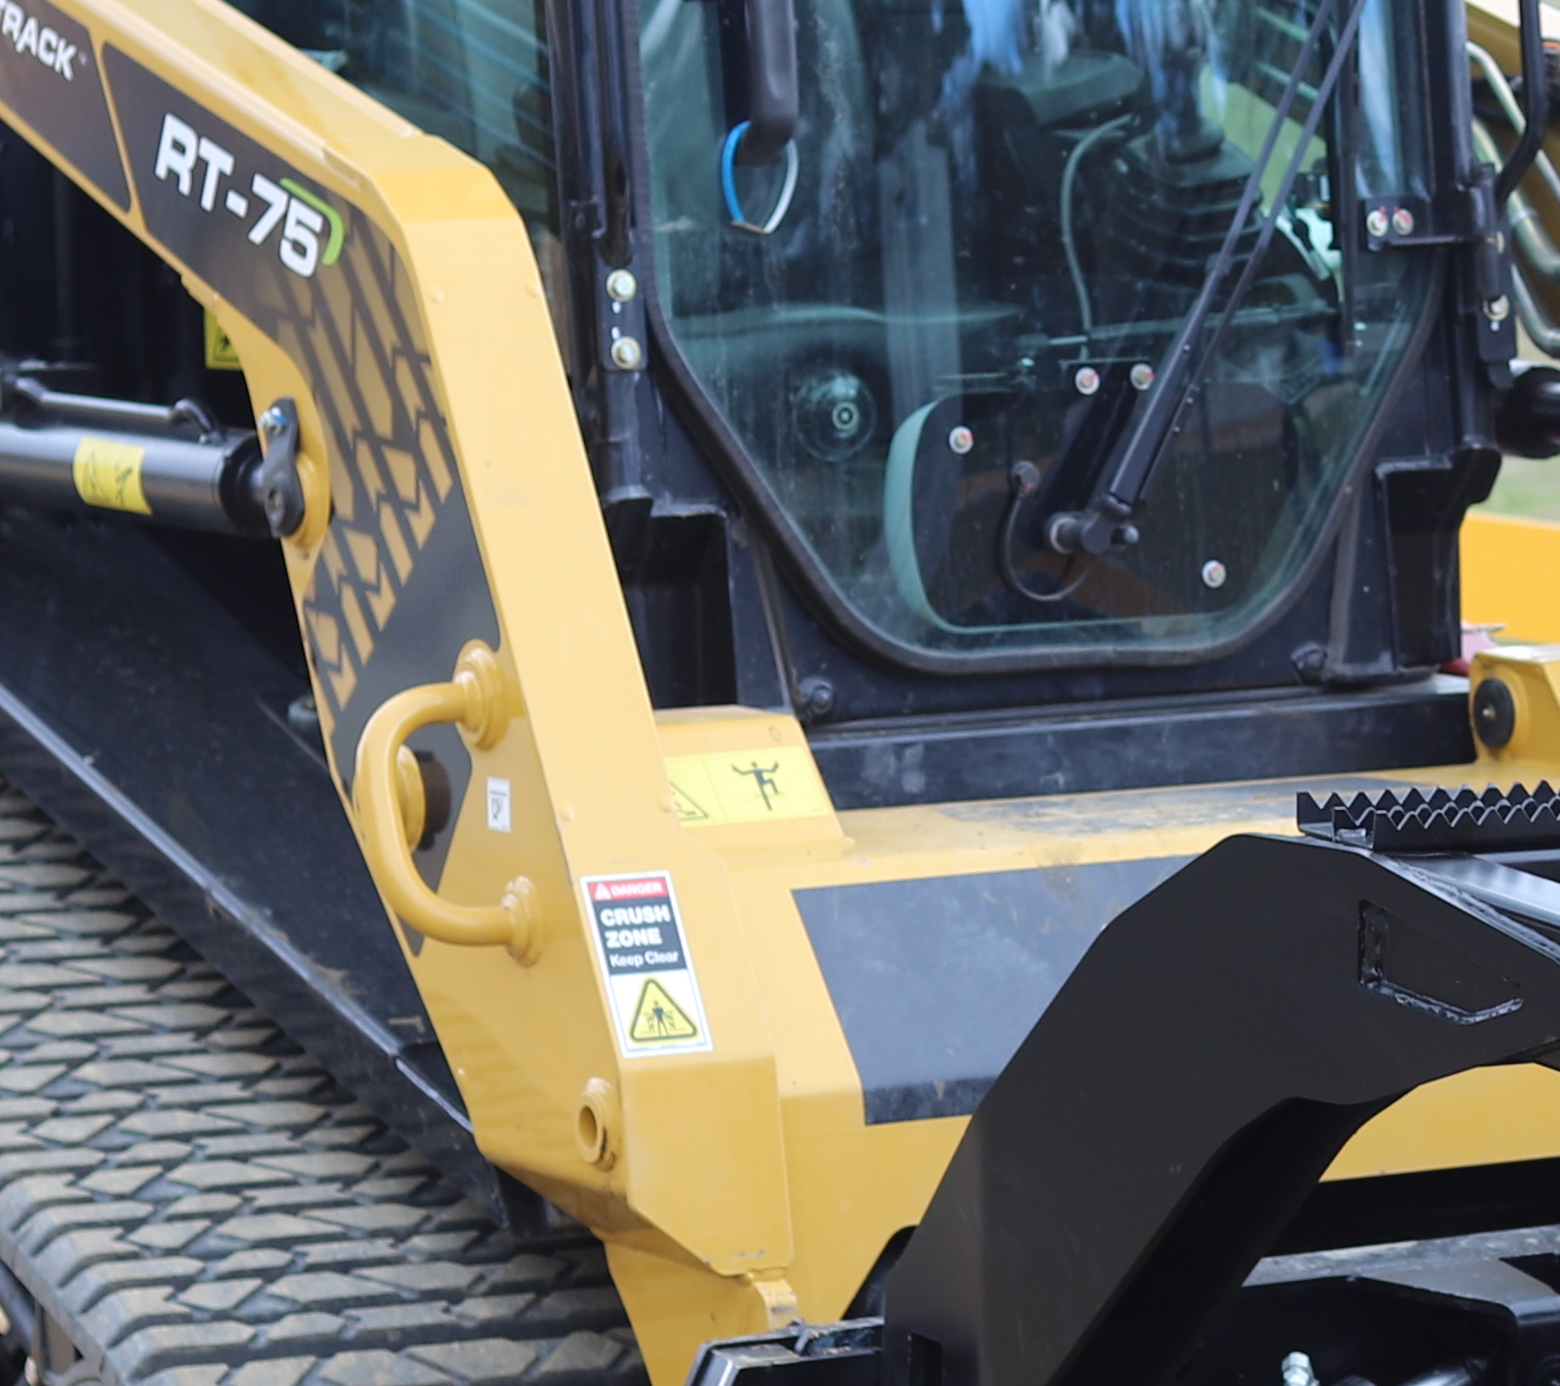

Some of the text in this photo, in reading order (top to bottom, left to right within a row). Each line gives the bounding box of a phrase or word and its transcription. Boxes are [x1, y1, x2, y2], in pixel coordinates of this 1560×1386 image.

[154, 113, 324, 279] RT-75
[611, 882, 663, 897] DANGER
[600, 904, 671, 927] CRUSH
[604, 927, 663, 949] ZONE
[609, 950, 679, 968] Keep Clear
